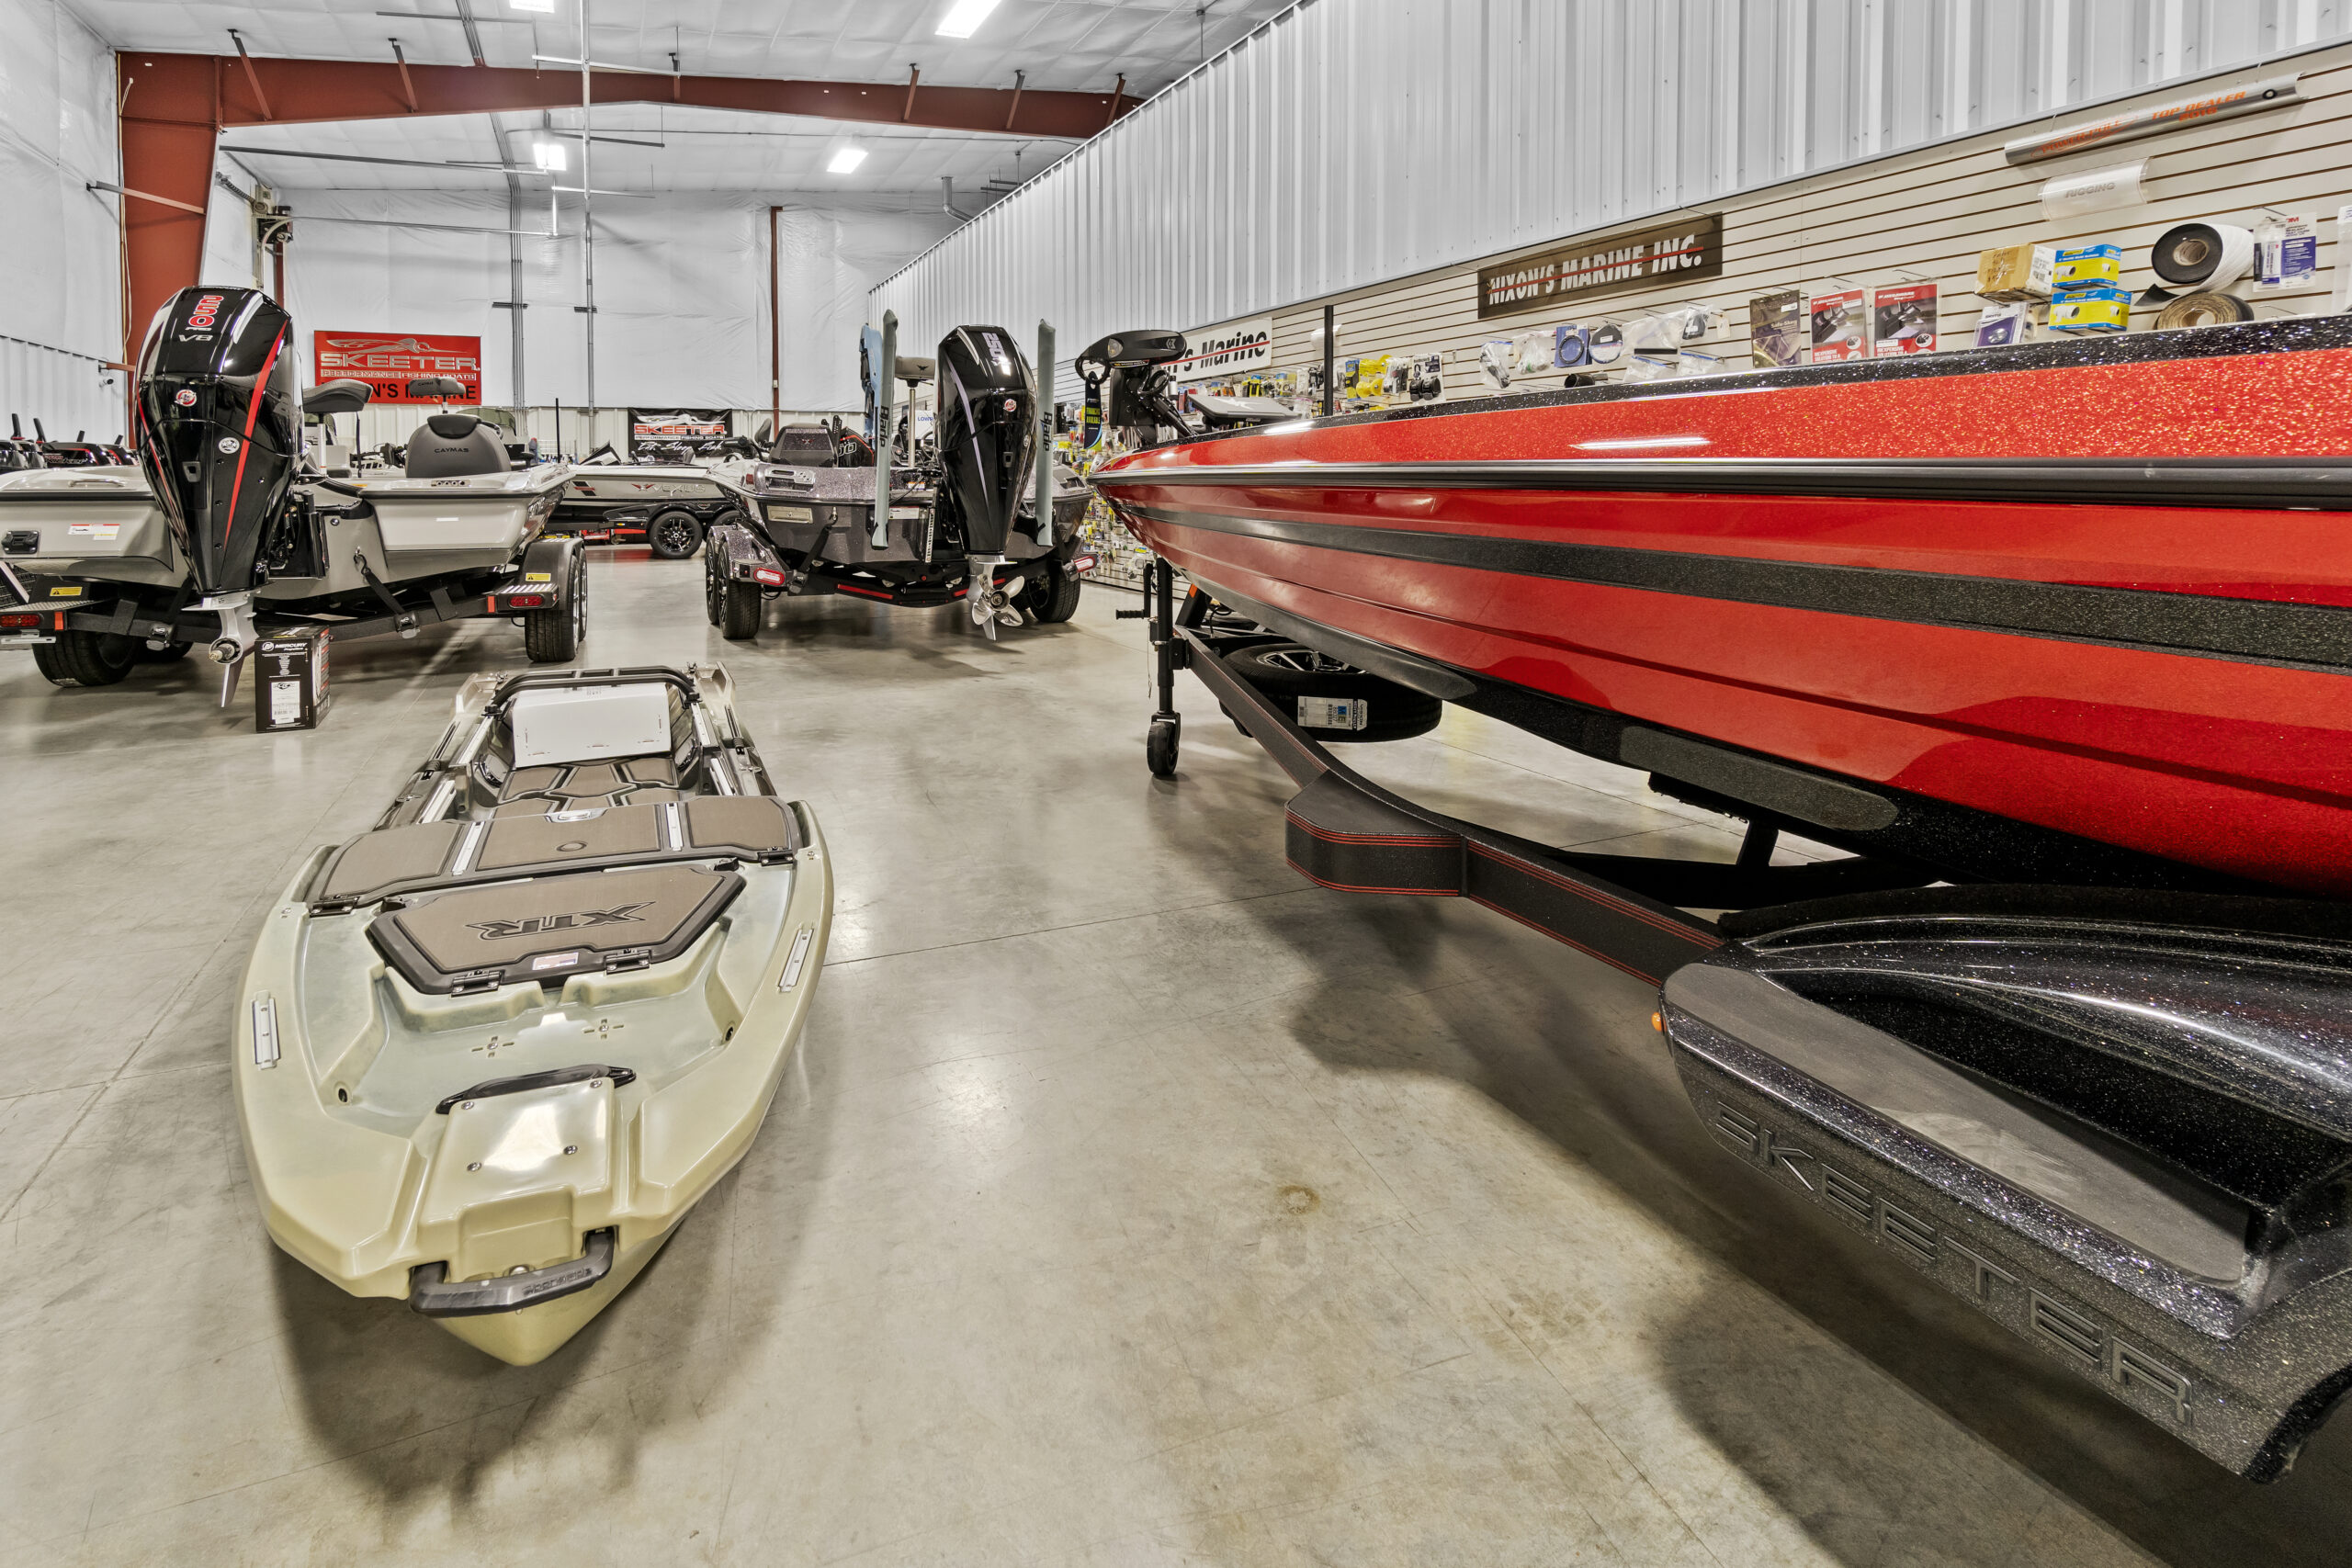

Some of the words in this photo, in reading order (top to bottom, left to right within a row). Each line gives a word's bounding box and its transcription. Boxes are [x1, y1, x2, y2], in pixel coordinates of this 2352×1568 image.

[2151, 106, 2180, 121] TOP
[2185, 91, 2246, 112] DEALER
[2064, 182, 2116, 198] RIGGING
[1489, 264, 1555, 305] NIXON'S
[1561, 245, 1645, 290] MARINE
[1652, 234, 1702, 274] INC.
[188, 295, 224, 327] 250
[320, 353, 477, 371] SKEETER
[1200, 331, 1268, 369] Marine
[322, 370, 401, 378] PERFORMANCE
[634, 423, 725, 434] SKEETER
[879, 405, 890, 448] Blade
[1040, 411, 1053, 452] Blade
[653, 483, 706, 493] VEXUS
[1715, 1100, 2194, 1427] SKEETER
